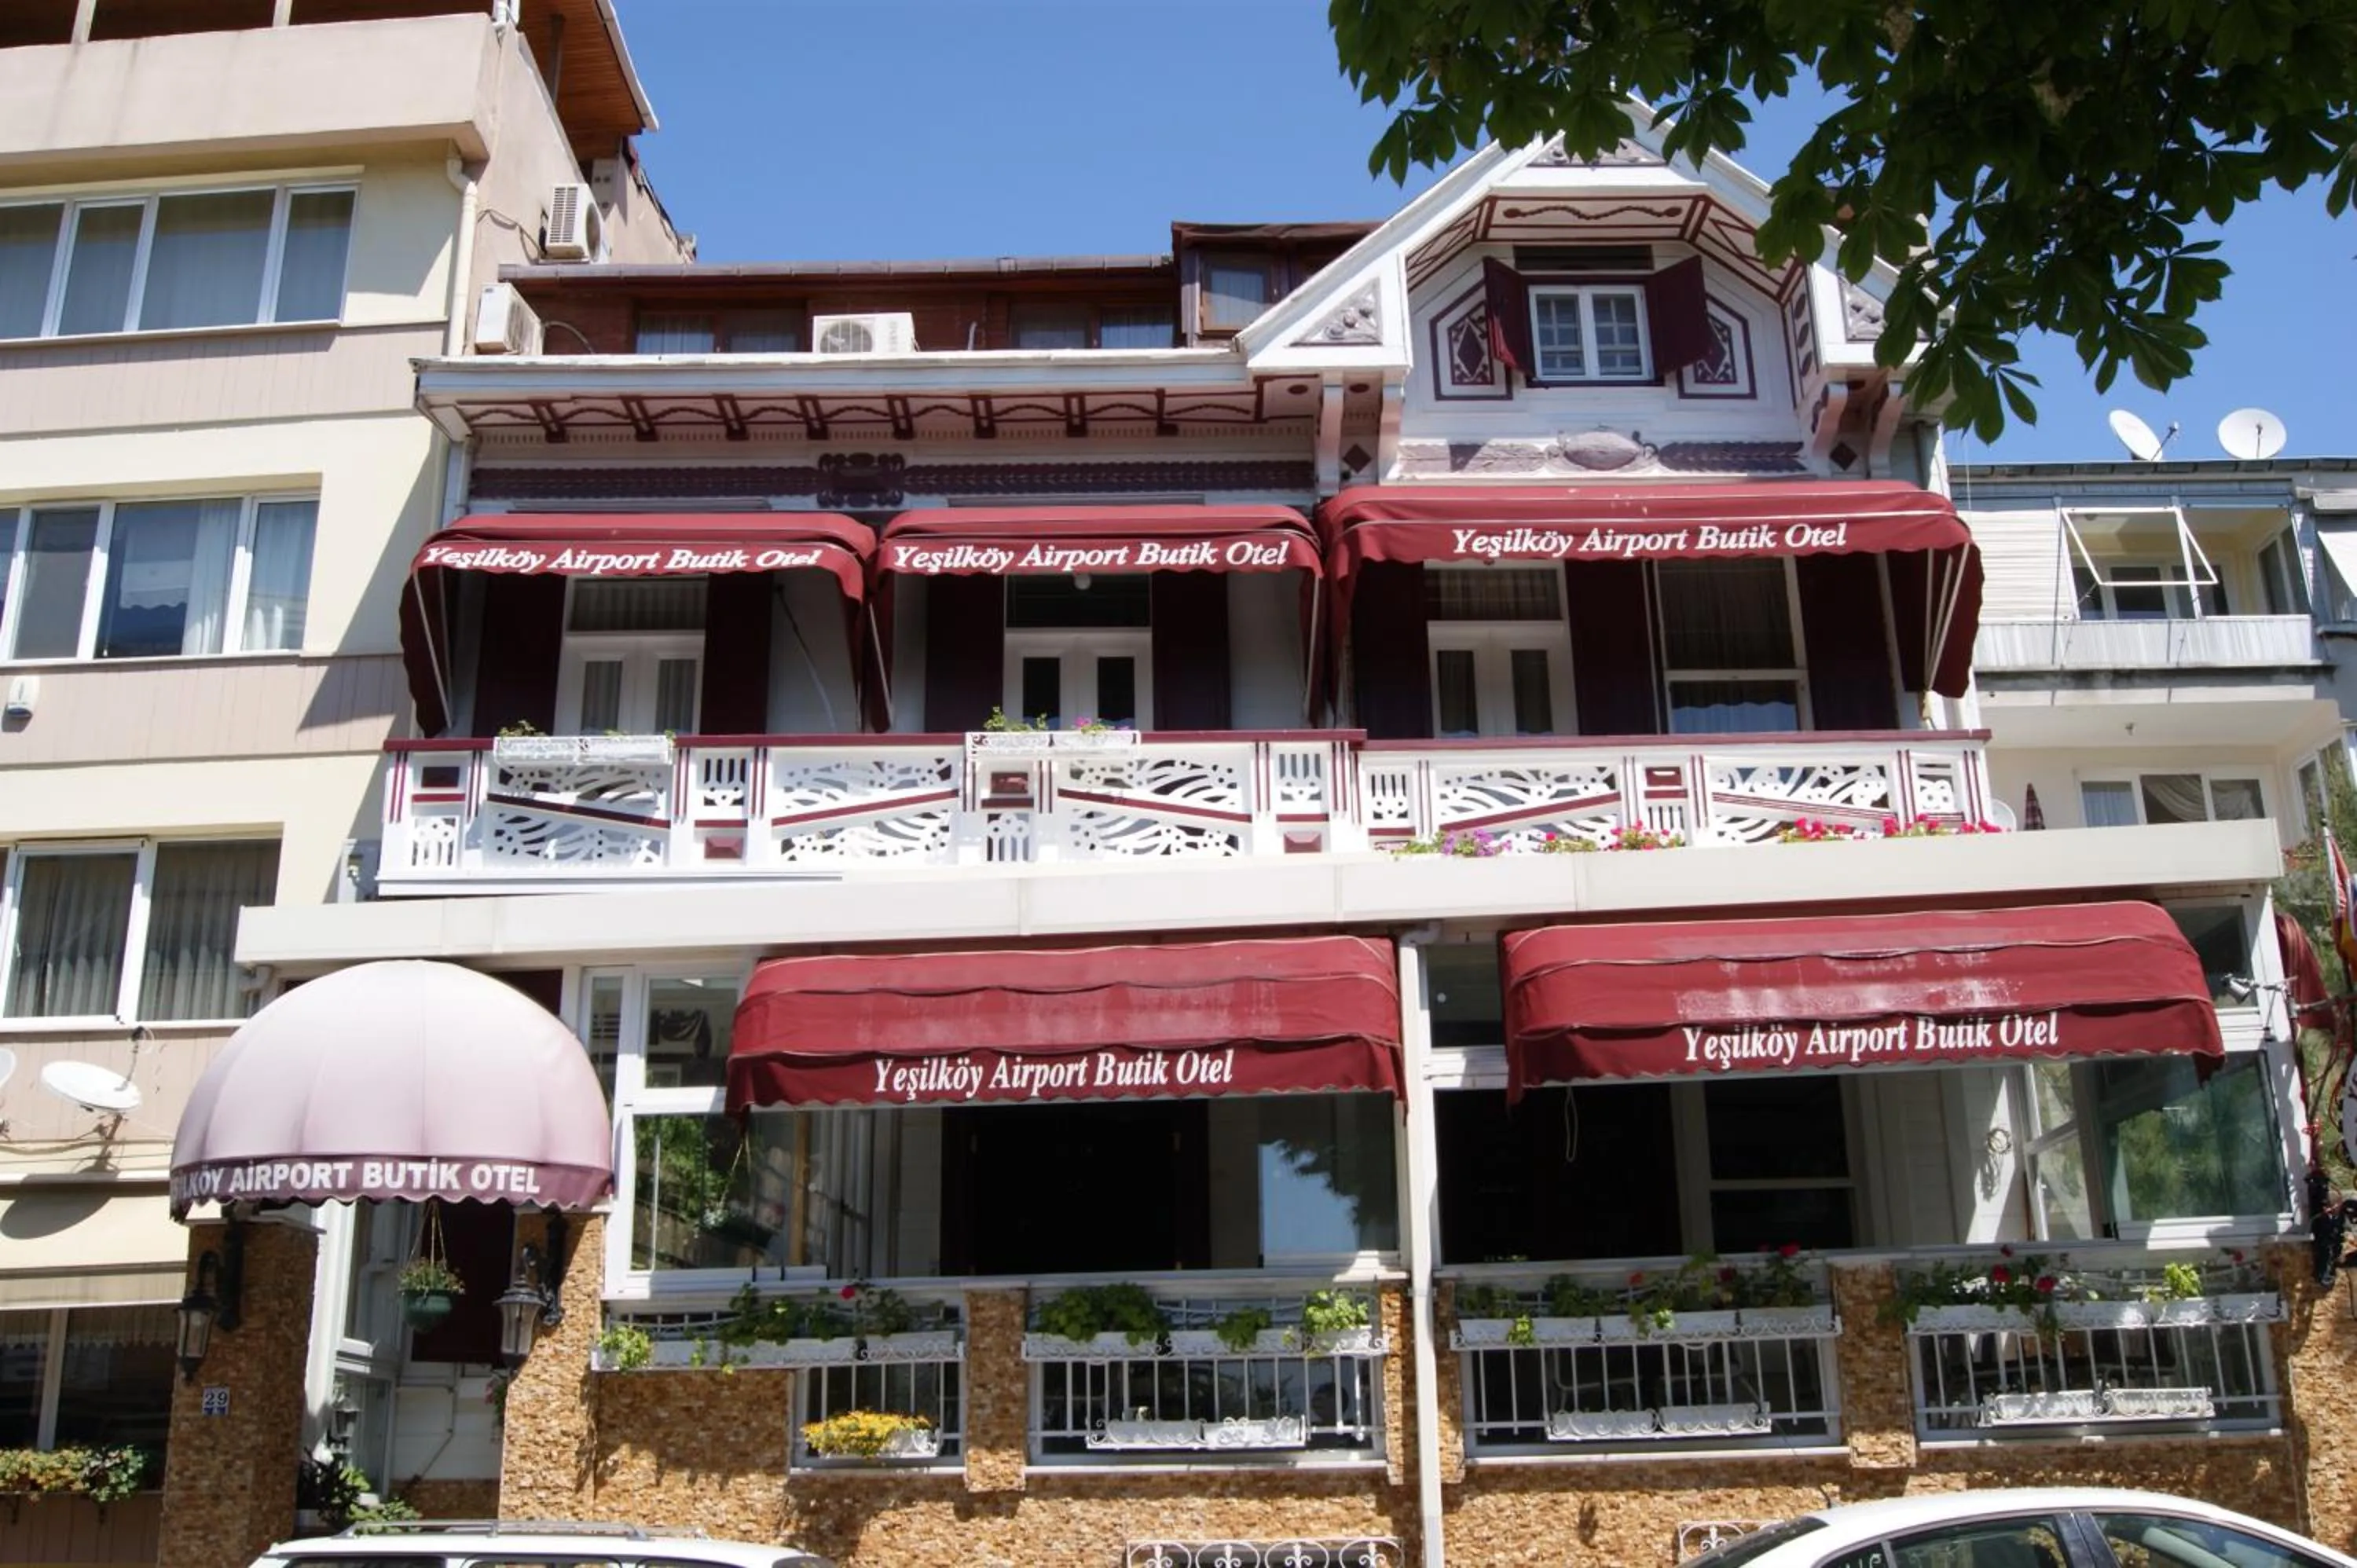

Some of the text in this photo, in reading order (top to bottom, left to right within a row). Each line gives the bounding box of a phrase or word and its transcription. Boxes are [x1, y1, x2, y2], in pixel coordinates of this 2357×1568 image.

[893, 540, 1289, 573] Yeşilköy Airport Butik Otel
[1452, 522, 1847, 559] Yeşilköy Airport Butik Otel
[424, 548, 823, 575] Yeşilköy Airport Butik Otel
[1682, 1011, 2059, 1070] Yeşilköy Airport Butik Otel
[874, 1049, 1235, 1101] Yeşilköy Airport Butik Otel
[228, 1160, 354, 1193] AİRPORT
[362, 1157, 462, 1190] BUTİK
[471, 1163, 541, 1194] OTEL
[206, 1391, 227, 1405] 29
